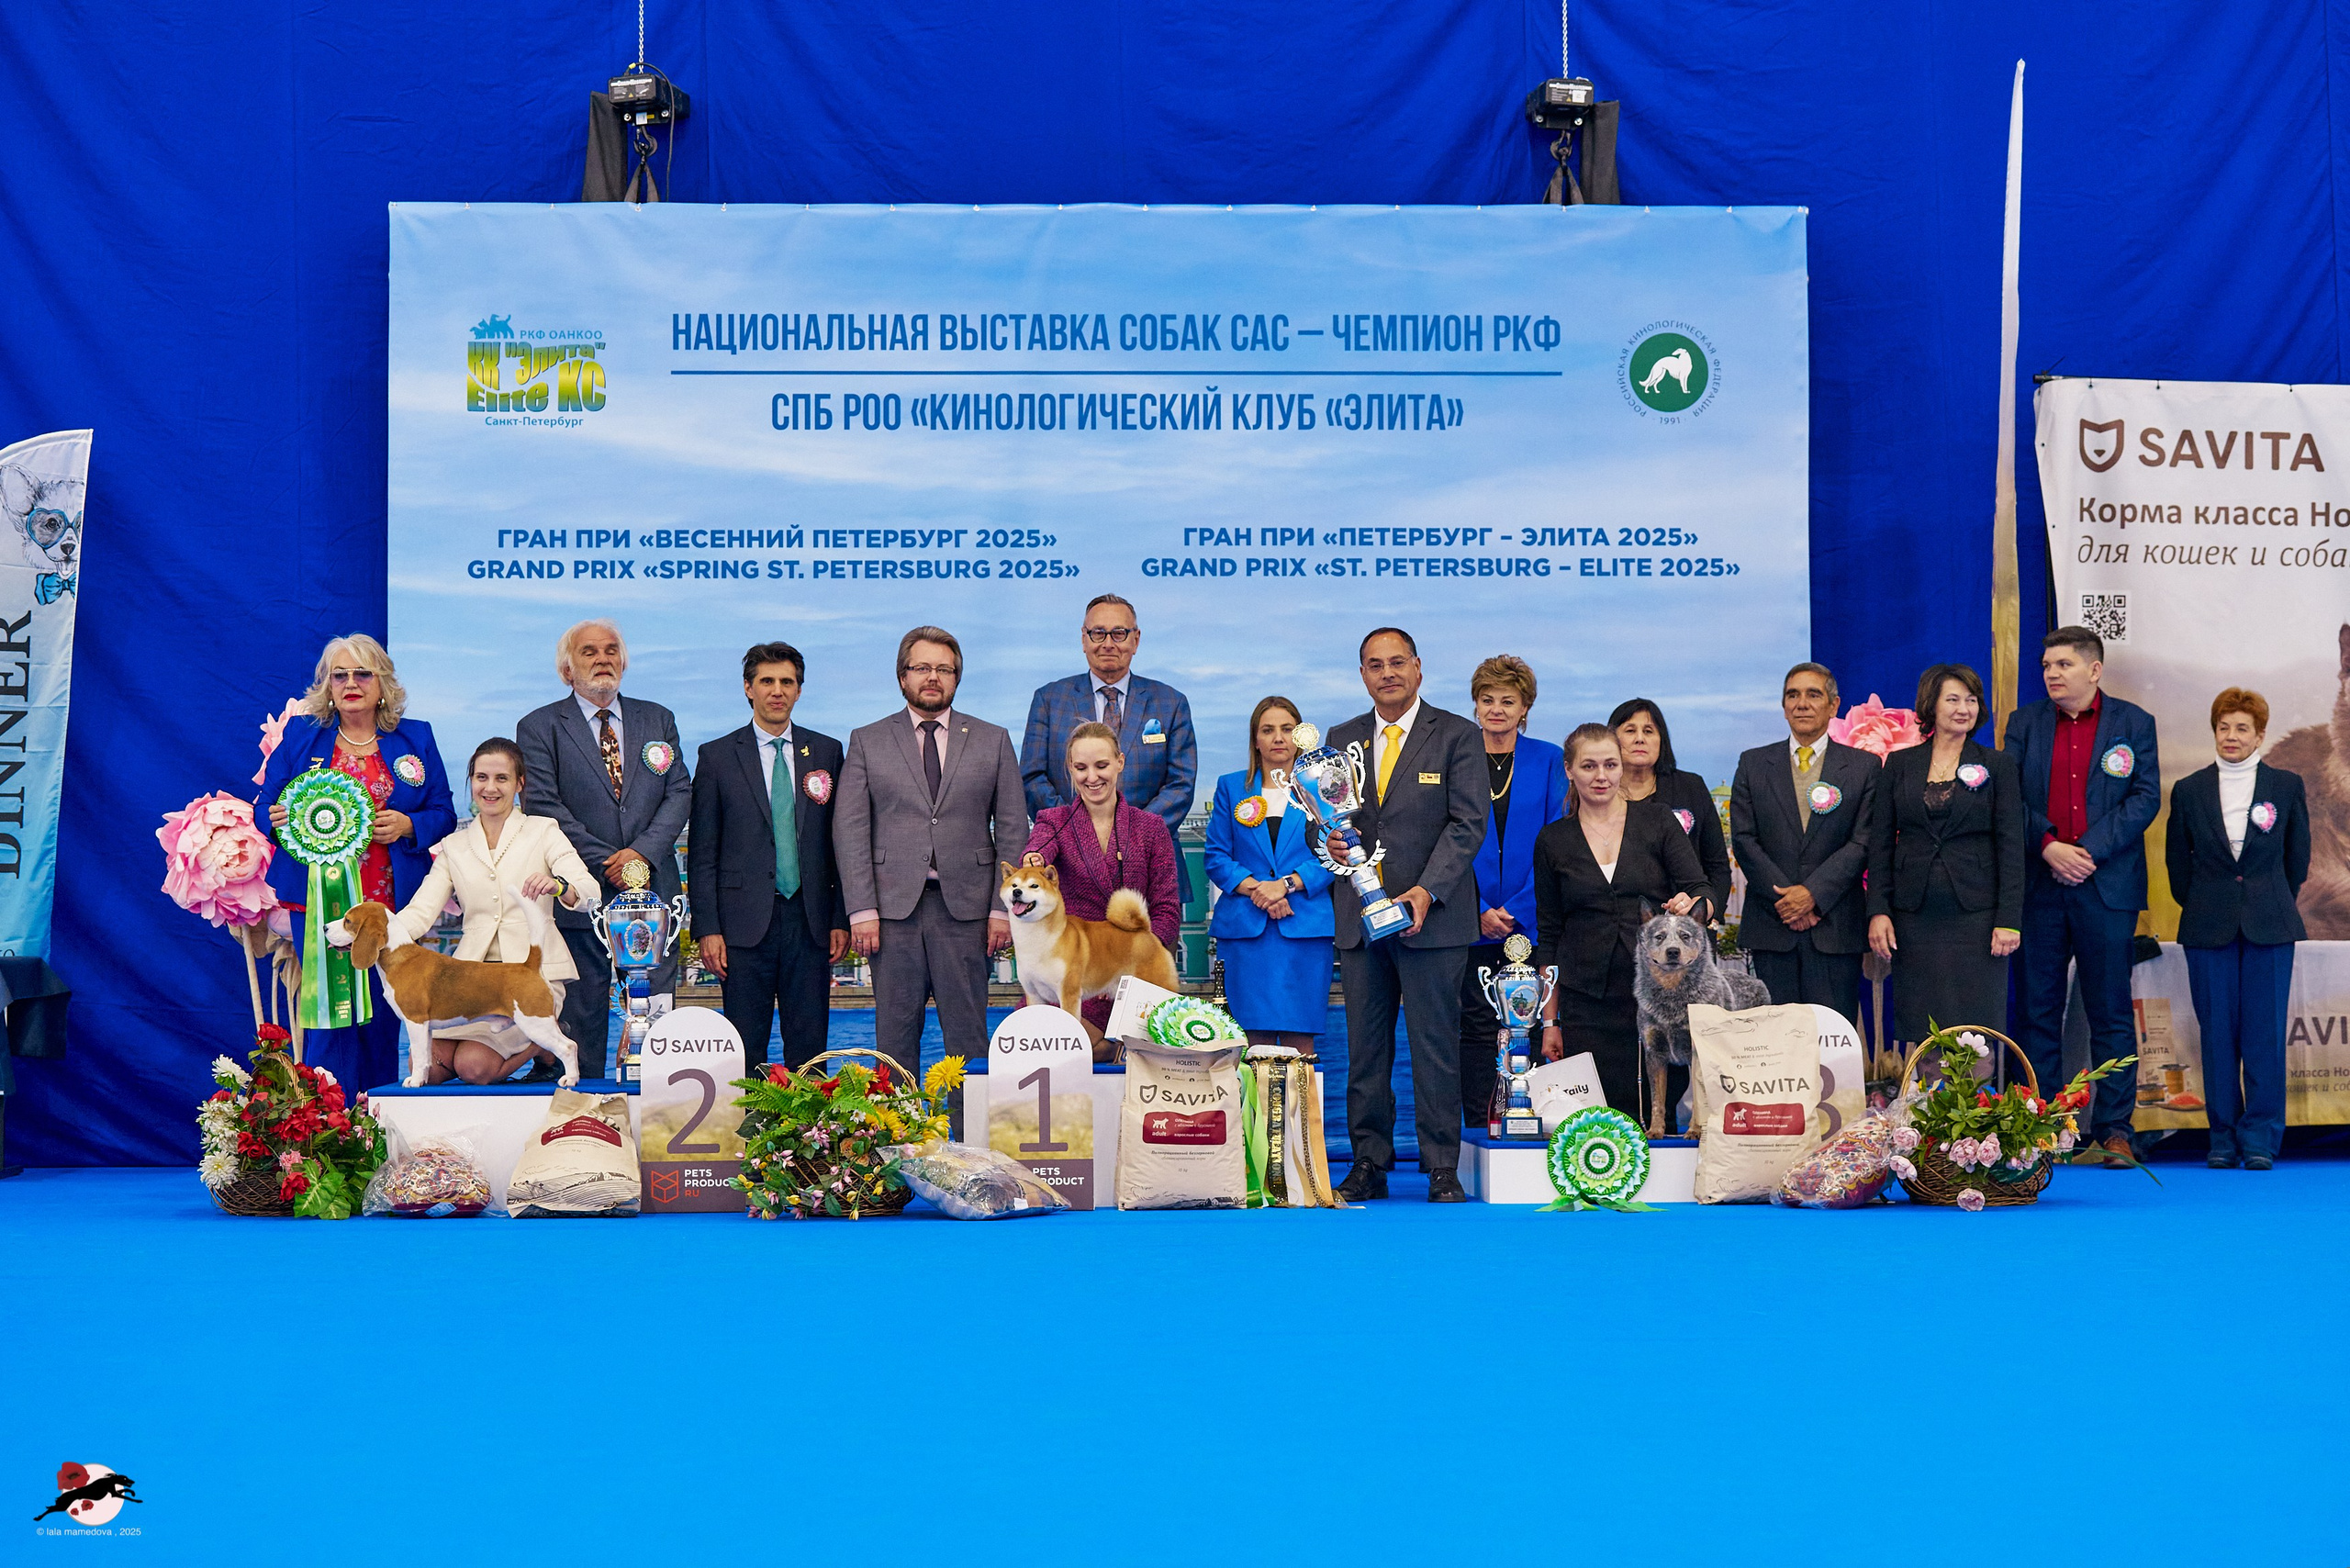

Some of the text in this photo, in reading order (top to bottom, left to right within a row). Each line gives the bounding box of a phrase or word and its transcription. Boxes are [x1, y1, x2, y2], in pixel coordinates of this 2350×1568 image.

[520, 330, 602, 340] РКФ ОАНКОО
[672, 313, 928, 355] НАЦИОНАЛЬНАЯ
[939, 313, 1110, 352] ВЫСТАВКА
[1119, 313, 1221, 352] СОБАК
[1332, 314, 1483, 353] ЧЕМПИОН
[1493, 314, 1561, 353] РКФ
[1617, 319, 1722, 417] РОССИЙСКАЯ КИНОЛОГИЧЕСКАЯ ФЕДЕРАЦИЯ
[466, 373, 549, 412] Elite
[771, 385, 1464, 431] СПБ РОО «КИНОЛОГИЧЕСКИЙ КЛУБ «ЭЛИТА»
[485, 416, 584, 428] Санкт-Петербург
[2138, 428, 2325, 473] SAVITA
[2078, 497, 2182, 530] Корма
[2194, 505, 2299, 527] класса
[498, 523, 1058, 549] ГРАН ПРИ «ВЕСЕННИЙ ПЕТЕРБУРГ 2025»
[1183, 527, 1252, 546] ГРАН
[1260, 527, 1315, 546] ПРИ
[1322, 527, 1493, 547] «ПЕТЕРБУРГ
[1521, 527, 1610, 546] ЭЛИТА
[1617, 527, 1698, 546] 2025»
[2077, 535, 2350, 567] для кошек и соба
[467, 559, 1080, 579] GRAND PRIX «SPRING ST. PETERSBURG 2025»
[1141, 557, 1237, 577] GRAND
[1246, 557, 1306, 577] PRIX
[1314, 557, 1367, 577] «ST.
[1375, 557, 1551, 577] PETERSBURG
[1580, 557, 1651, 577] ELITE
[1660, 557, 1740, 577] 2025»
[2287, 1015, 2348, 1046] AVI
[671, 1039, 735, 1053] SAVITA
[1019, 1037, 1083, 1051] SAVITA
[2143, 1047, 2170, 1055] SAVITA
[1739, 1077, 1810, 1095] SAVITA
[666, 1068, 721, 1154] 2
[1018, 1067, 1069, 1152] 1
[684, 1169, 712, 1177] PETS
[1033, 1167, 1060, 1175] PETS
[684, 1179, 730, 1187] PRODUC
